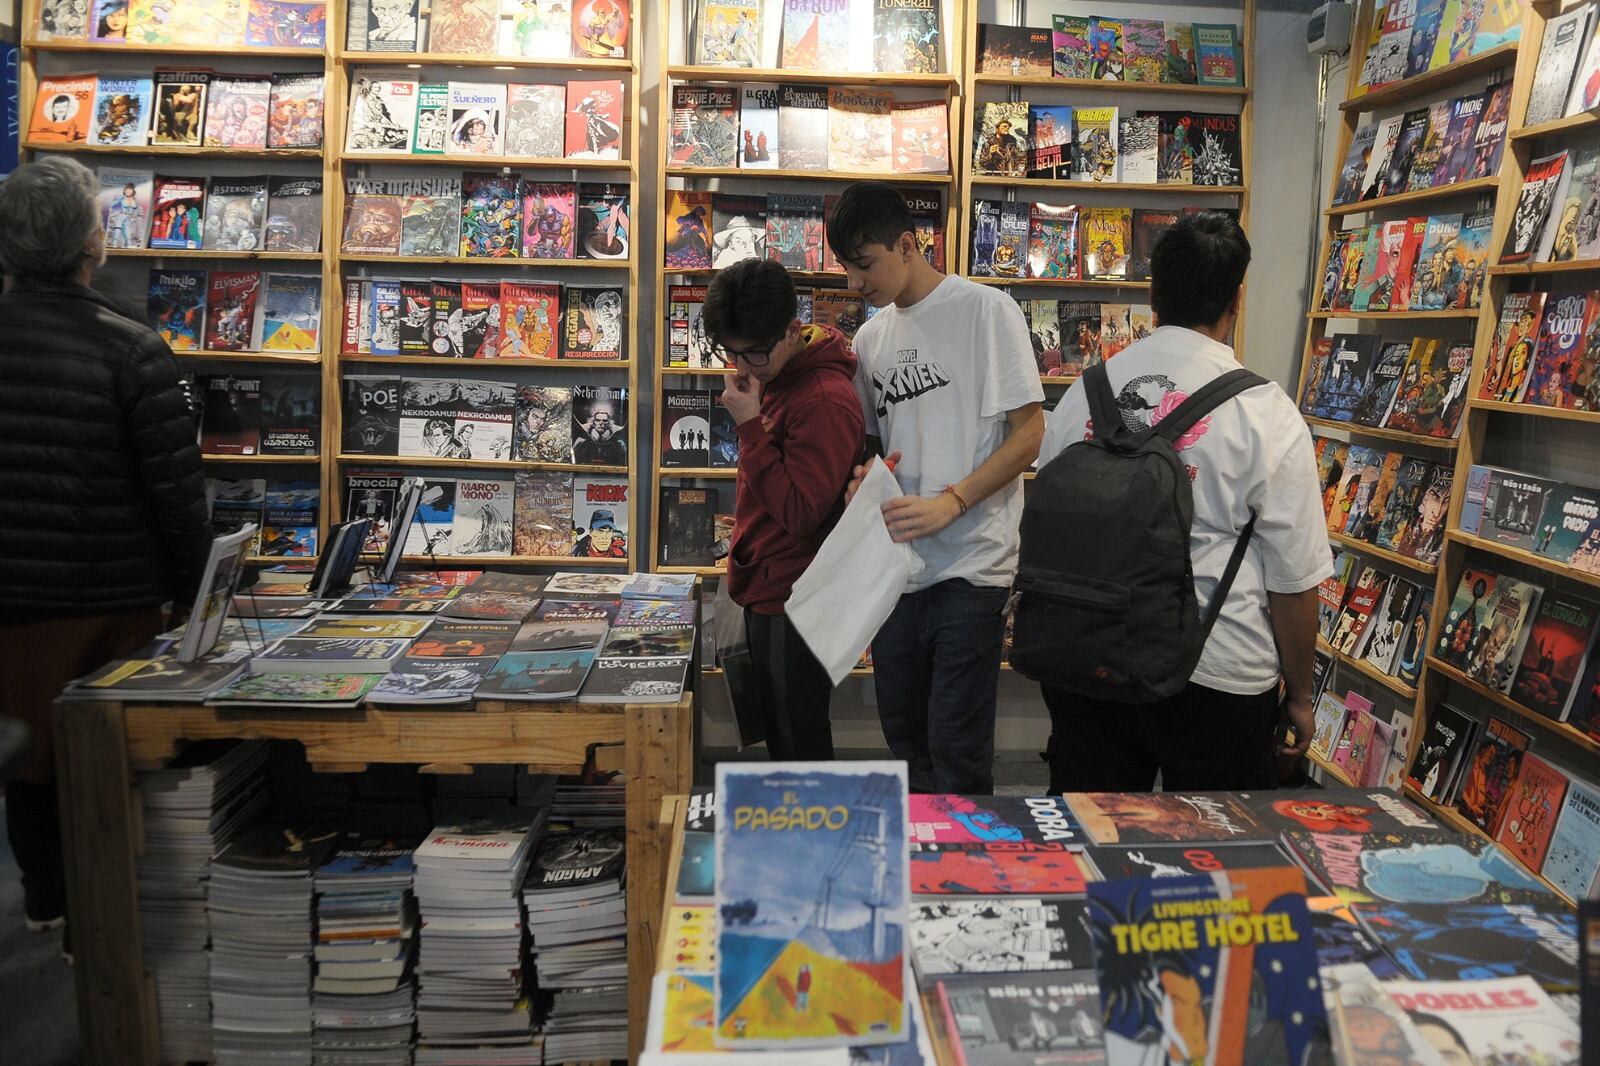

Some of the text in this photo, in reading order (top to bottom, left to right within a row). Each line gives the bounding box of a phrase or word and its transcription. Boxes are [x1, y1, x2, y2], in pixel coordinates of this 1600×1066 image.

[43, 81, 94, 92] Precinto
[75, 91, 88, 100] 56
[709, 93, 731, 104] PIKE
[348, 179, 386, 195] WAR
[214, 273, 258, 290] ELVISMAN
[347, 283, 359, 345] GILGAMESH
[567, 288, 580, 350] GILGAMESH
[363, 389, 398, 406] POE
[402, 409, 456, 418] NEKRODAMUS
[457, 411, 512, 421] NEKRODAMUS
[348, 477, 399, 488] breccia
[461, 483, 500, 492] MARCO
[461, 491, 494, 500] MONO
[734, 806, 848, 831] PASADO
[1024, 797, 1074, 842] DORA
[1152, 897, 1251, 919] LIVINGSTONE
[1110, 913, 1299, 955] TIGRE HOTEL
[1390, 988, 1538, 1011] DOBLES
